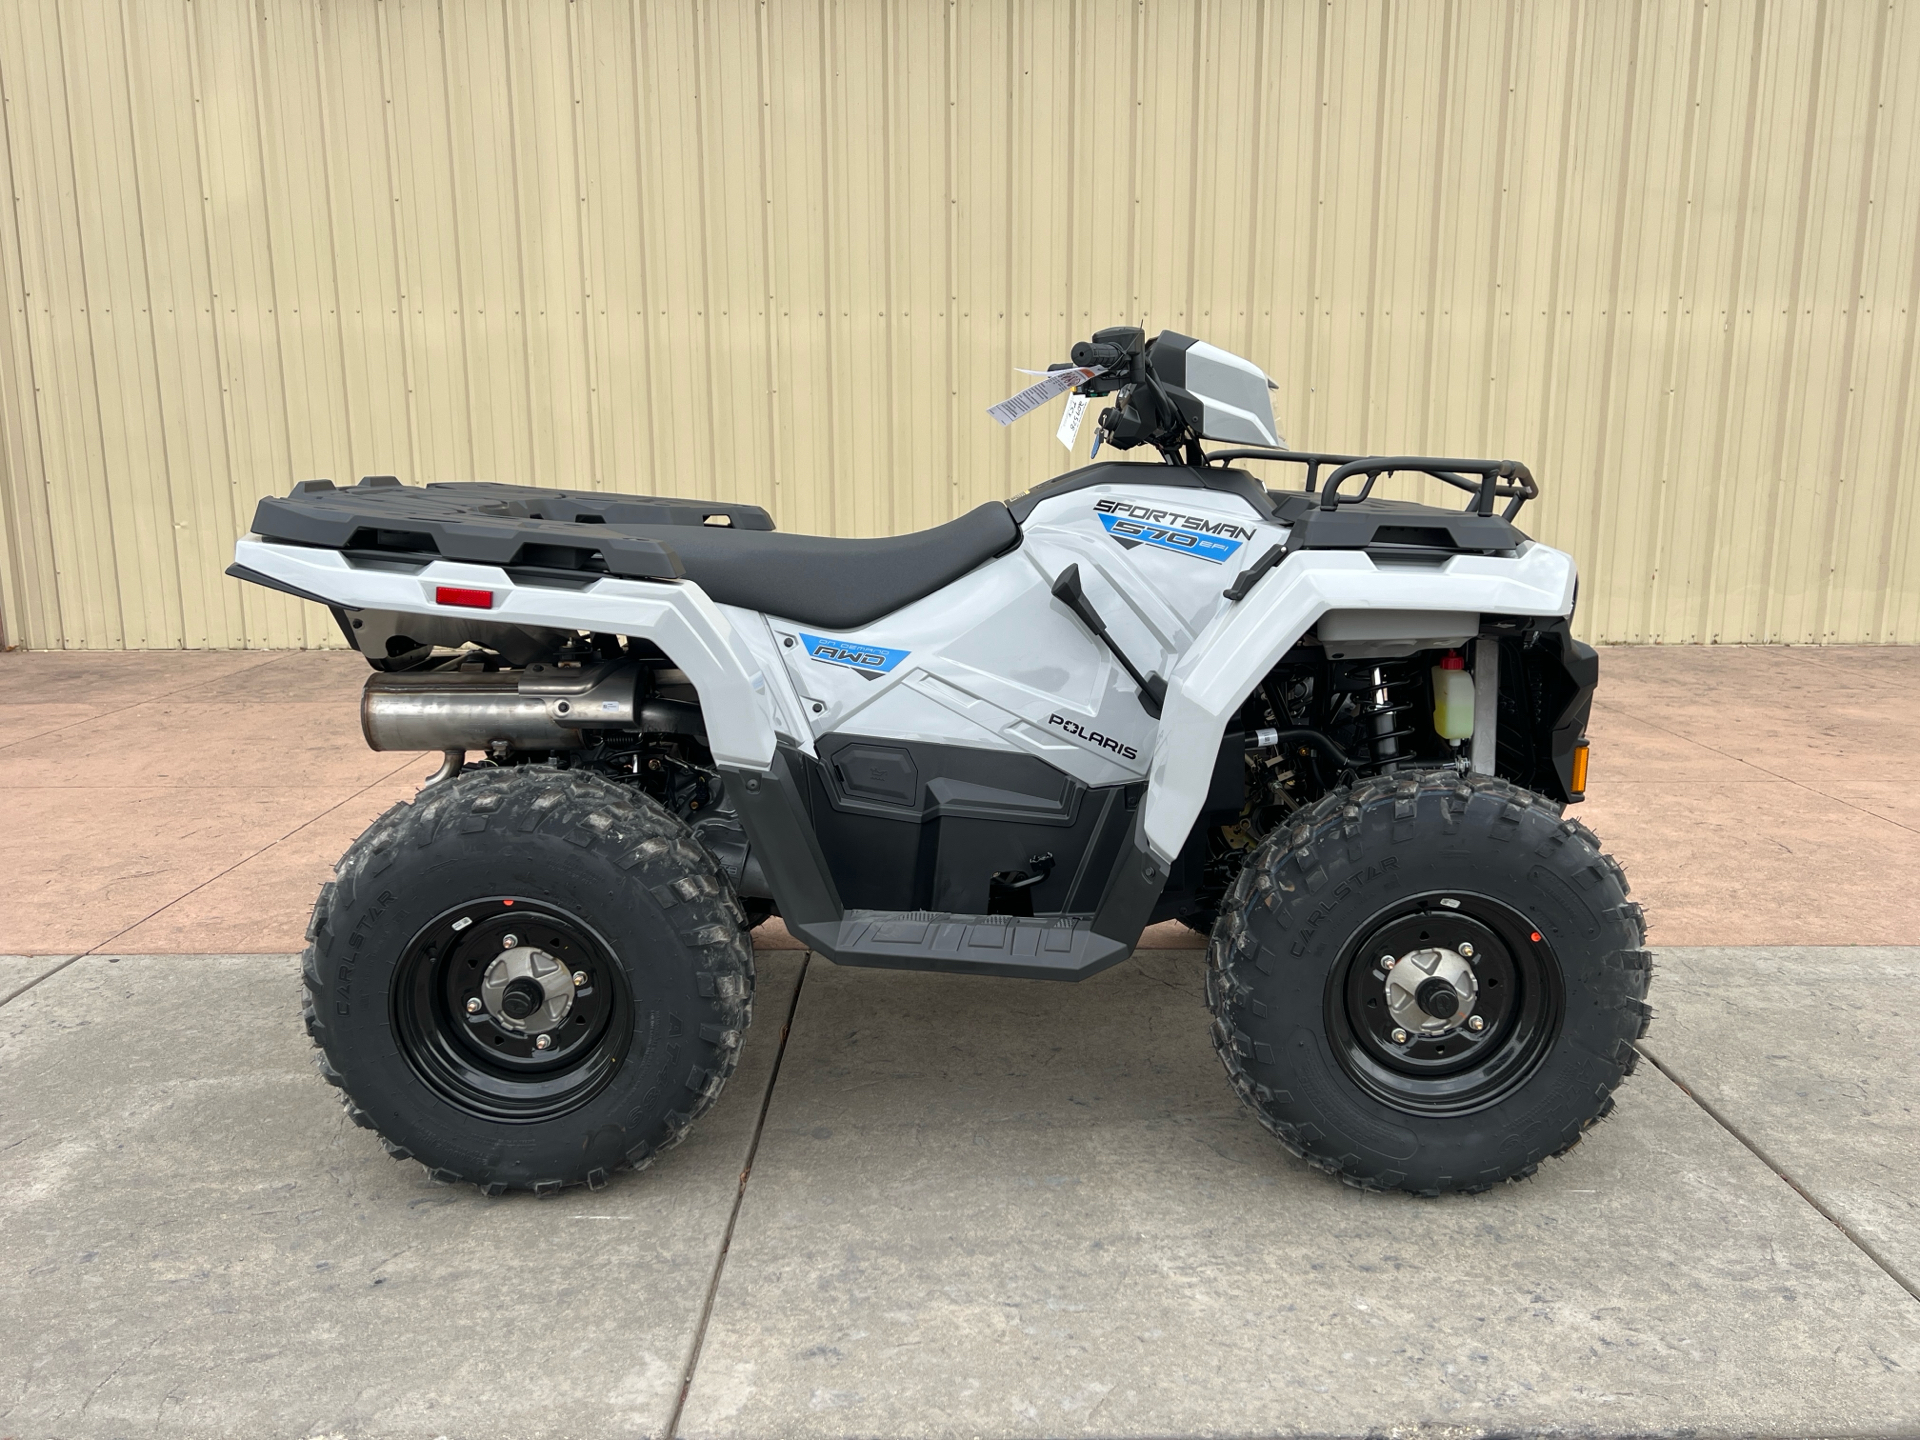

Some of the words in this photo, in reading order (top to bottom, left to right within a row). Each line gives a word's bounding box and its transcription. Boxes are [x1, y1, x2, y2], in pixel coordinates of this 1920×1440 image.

[1093, 499, 1257, 541] SPORTSMAN
[1110, 519, 1199, 549] 570
[1199, 540, 1229, 551] EFI
[813, 644, 886, 667] AWD
[1048, 713, 1138, 760] POLARIS
[1289, 854, 1401, 959] CARLSTAR
[335, 888, 399, 1018] CARLSTAR
